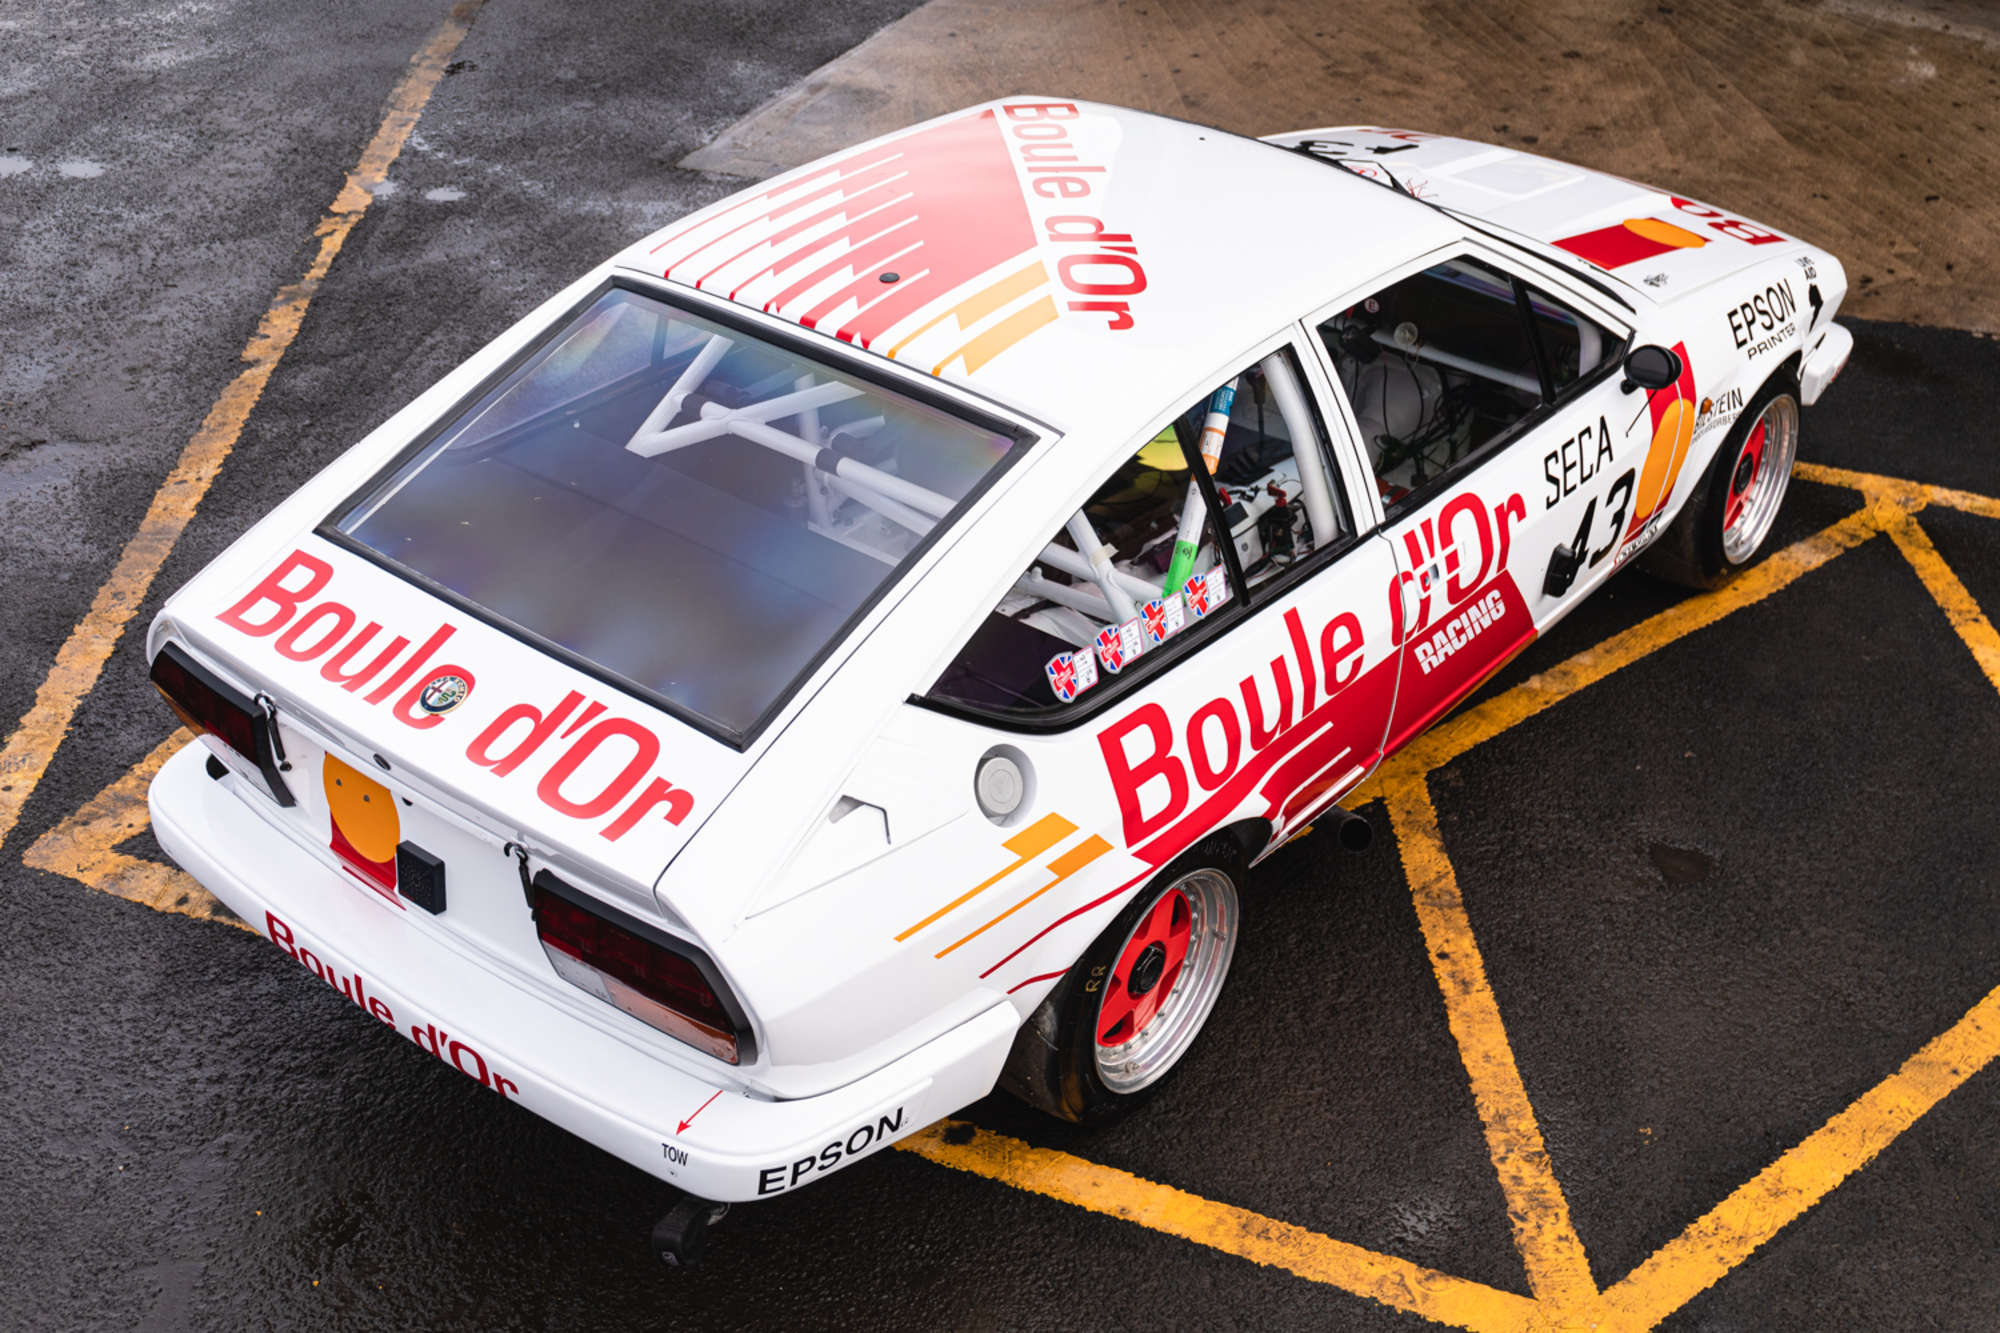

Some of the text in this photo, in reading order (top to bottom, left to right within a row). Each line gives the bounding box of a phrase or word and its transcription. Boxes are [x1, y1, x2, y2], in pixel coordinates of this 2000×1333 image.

[1002, 102, 1148, 331] Boule d'Or
[1726, 277, 1797, 350] EPSON
[1543, 414, 1614, 511] SECA
[1566, 466, 1637, 570] 43
[1096, 492, 1528, 849] Boule d'Or
[1413, 588, 1507, 676] RACING
[214, 547, 695, 843] Boule d'Or
[264, 909, 520, 1097] Boule d'Or
[661, 1142, 689, 1167] TOW
[756, 1106, 904, 1196] EPSON
